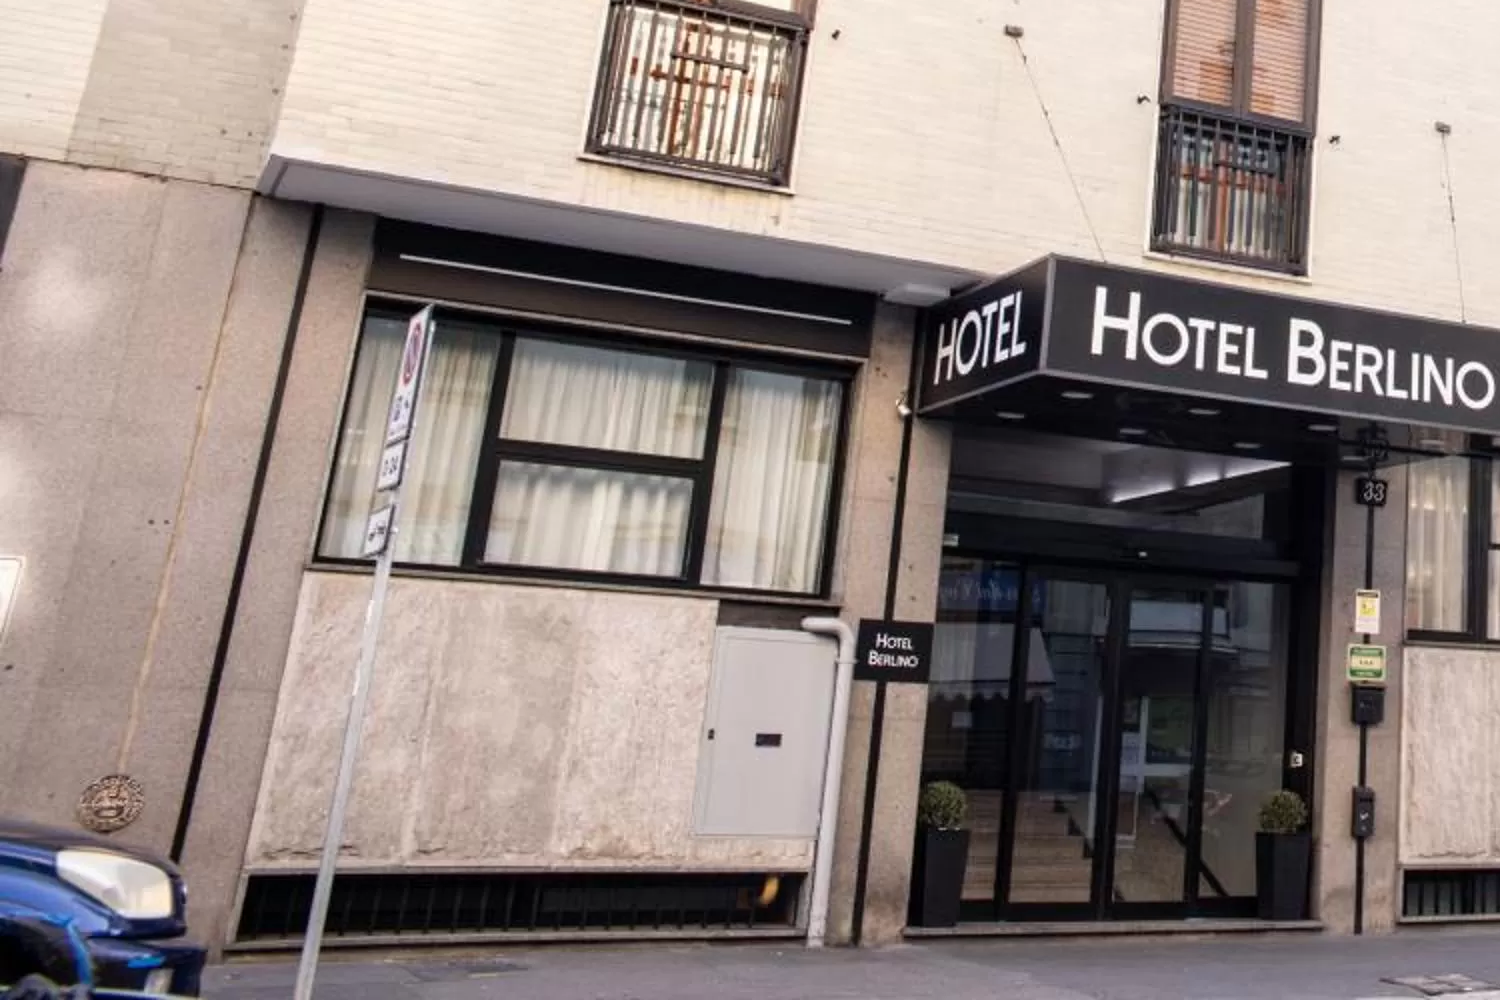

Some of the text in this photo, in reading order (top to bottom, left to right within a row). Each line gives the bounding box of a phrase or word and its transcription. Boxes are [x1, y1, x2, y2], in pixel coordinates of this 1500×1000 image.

[933, 291, 1027, 386] HOTEL
[1091, 286, 1496, 411] HOTEL BERLINO
[1363, 480, 1385, 501] 33
[875, 632, 914, 650] HOTEL
[867, 649, 919, 668] BERLINO
